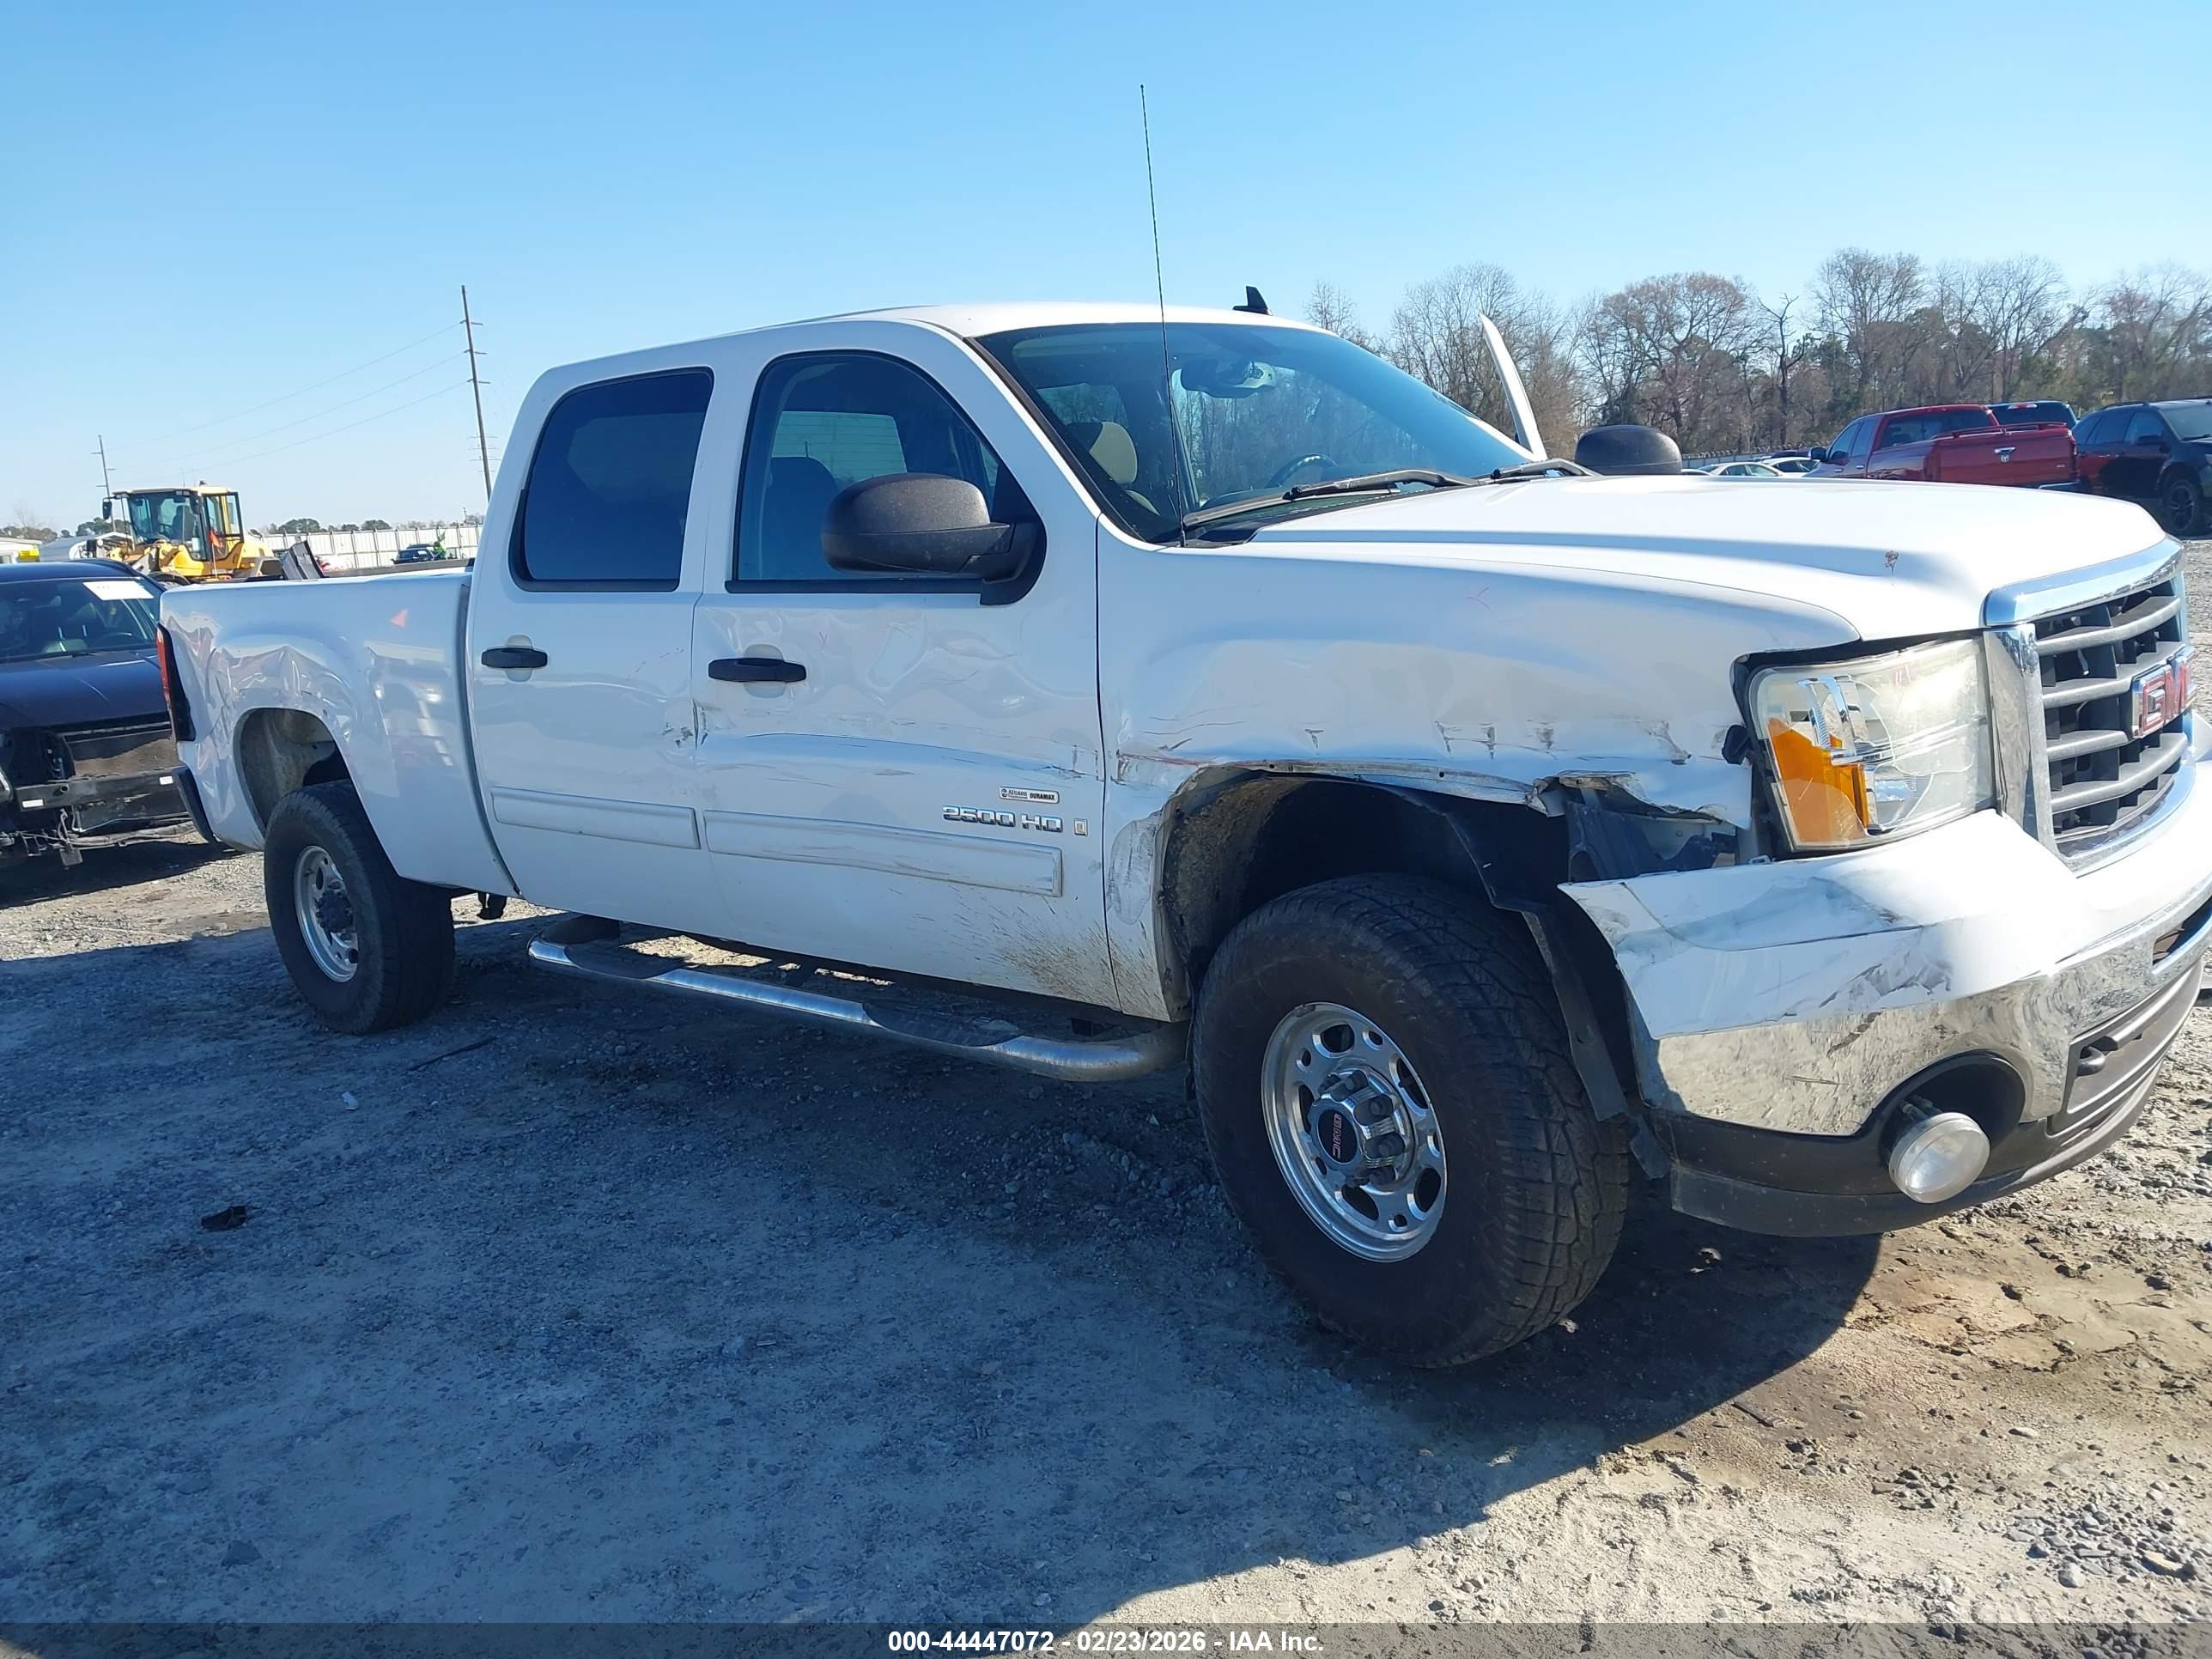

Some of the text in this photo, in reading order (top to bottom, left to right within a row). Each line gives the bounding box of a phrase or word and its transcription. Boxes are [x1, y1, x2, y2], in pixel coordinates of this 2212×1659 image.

[1030, 792, 1055, 801] DURAMAX
[943, 805, 1016, 827] 2500
[1021, 813, 1063, 833] HD
